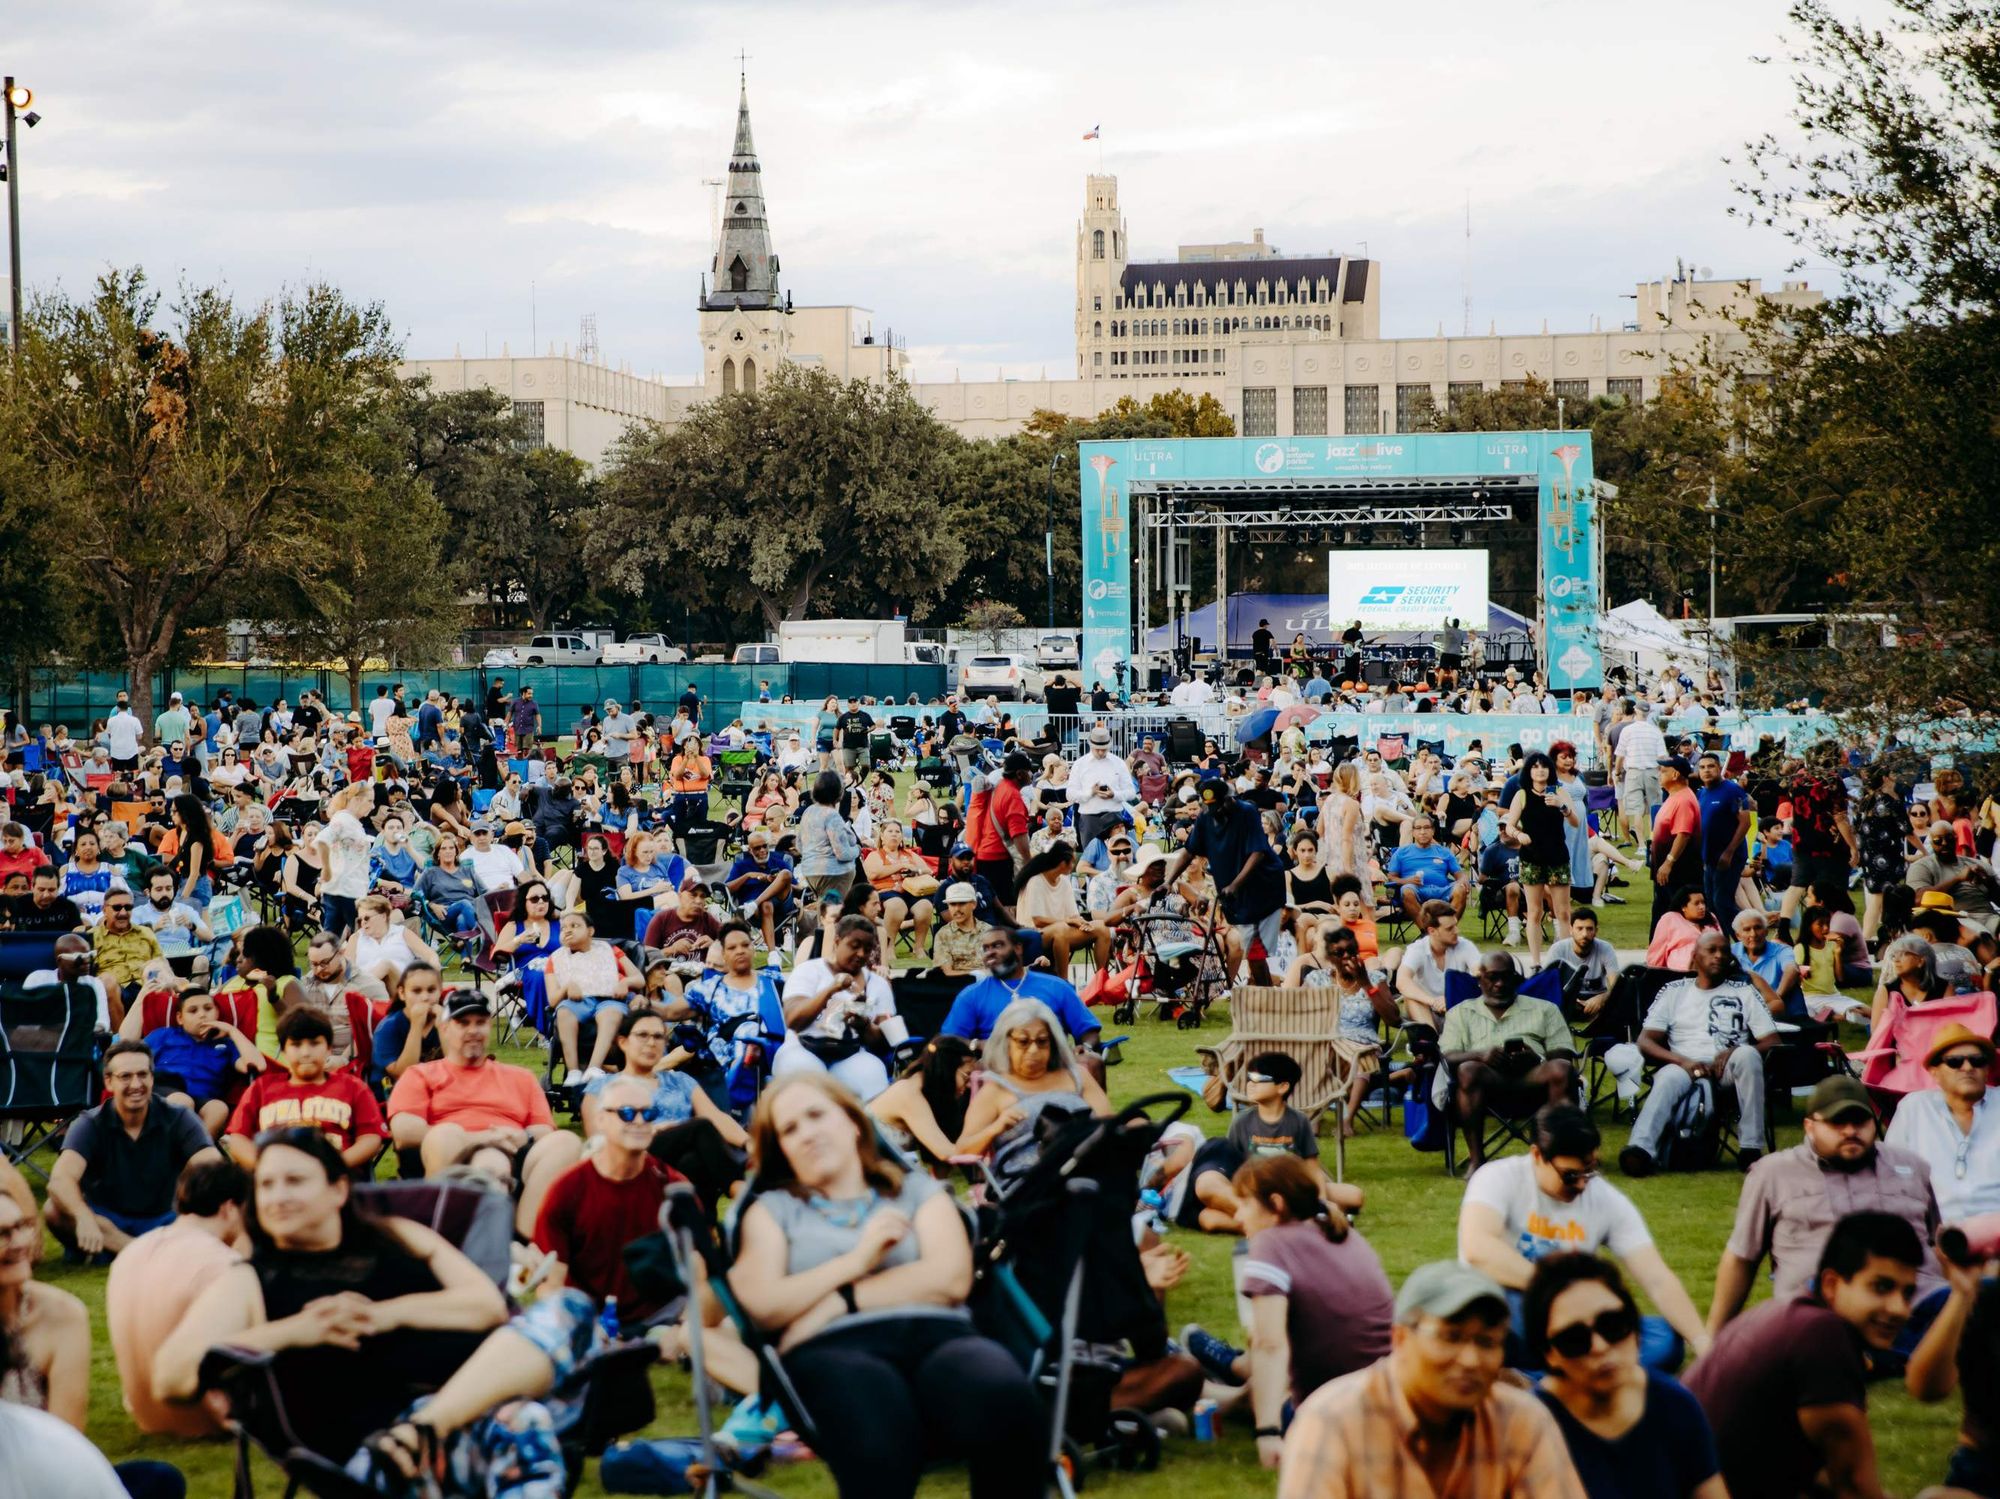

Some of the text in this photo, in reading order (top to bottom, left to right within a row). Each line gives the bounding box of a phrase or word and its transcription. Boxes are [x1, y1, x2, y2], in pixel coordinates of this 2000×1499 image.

[1487, 445, 1528, 455] ULTRA
[1134, 452, 1173, 461] ULTRA
[1407, 585, 1460, 595] SECURITY
[1400, 595, 1449, 605] SERVICE
[1520, 724, 1594, 749] go all ou
